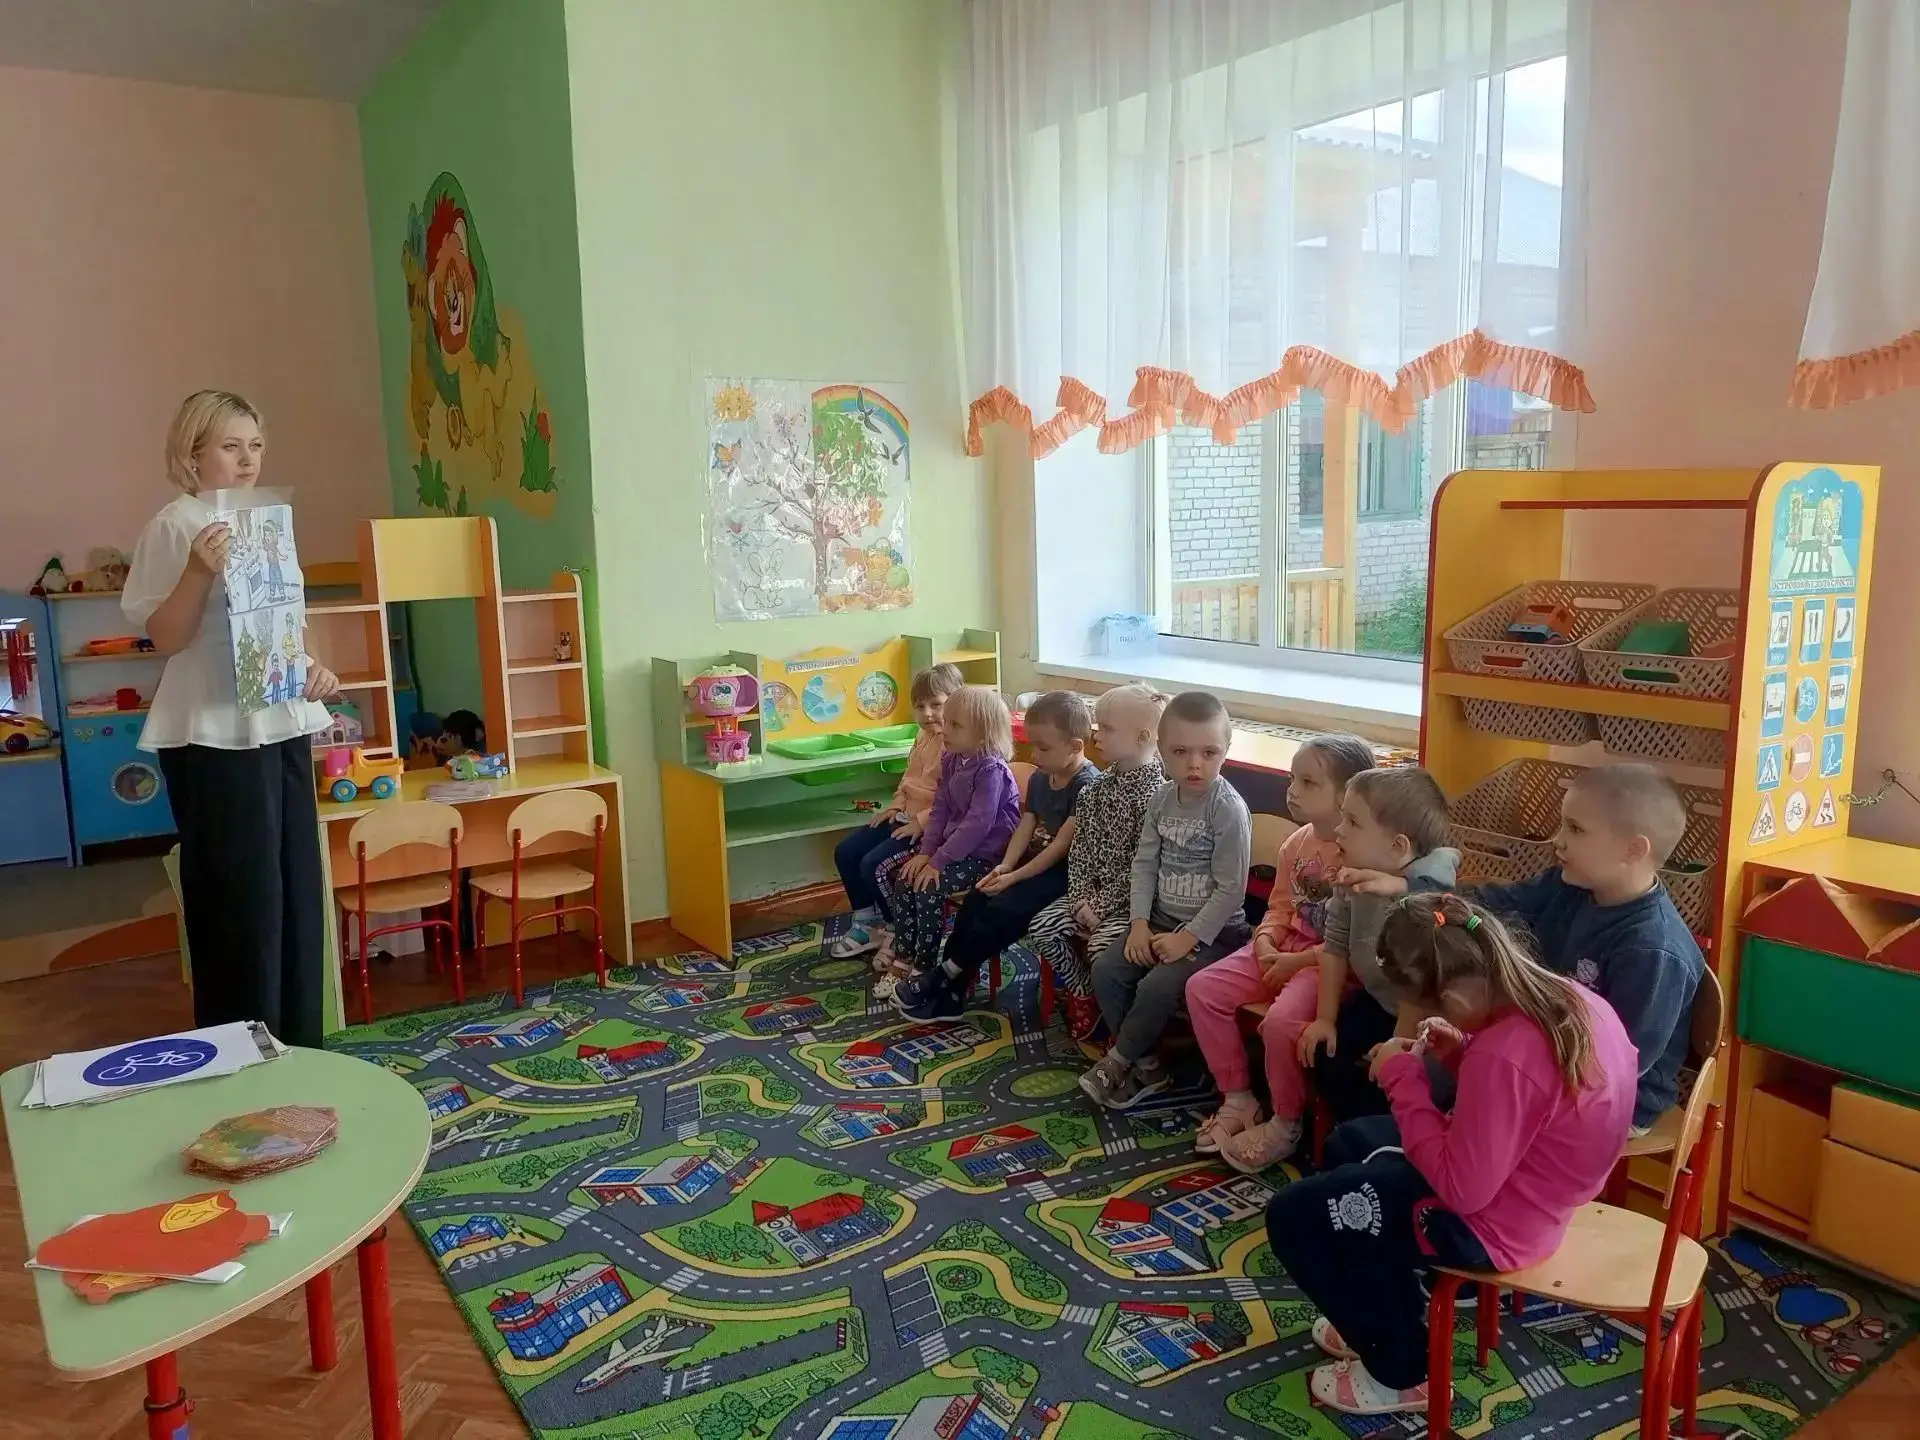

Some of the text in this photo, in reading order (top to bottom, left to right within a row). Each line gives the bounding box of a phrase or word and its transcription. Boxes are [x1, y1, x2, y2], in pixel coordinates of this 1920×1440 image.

[1327, 1198, 1343, 1231] STATE
[1360, 1182, 1382, 1236] MICHIGAN
[459, 1243, 517, 1269] BUS
[555, 1278, 602, 1309] AIRPORT
[939, 1402, 964, 1431] WASH
